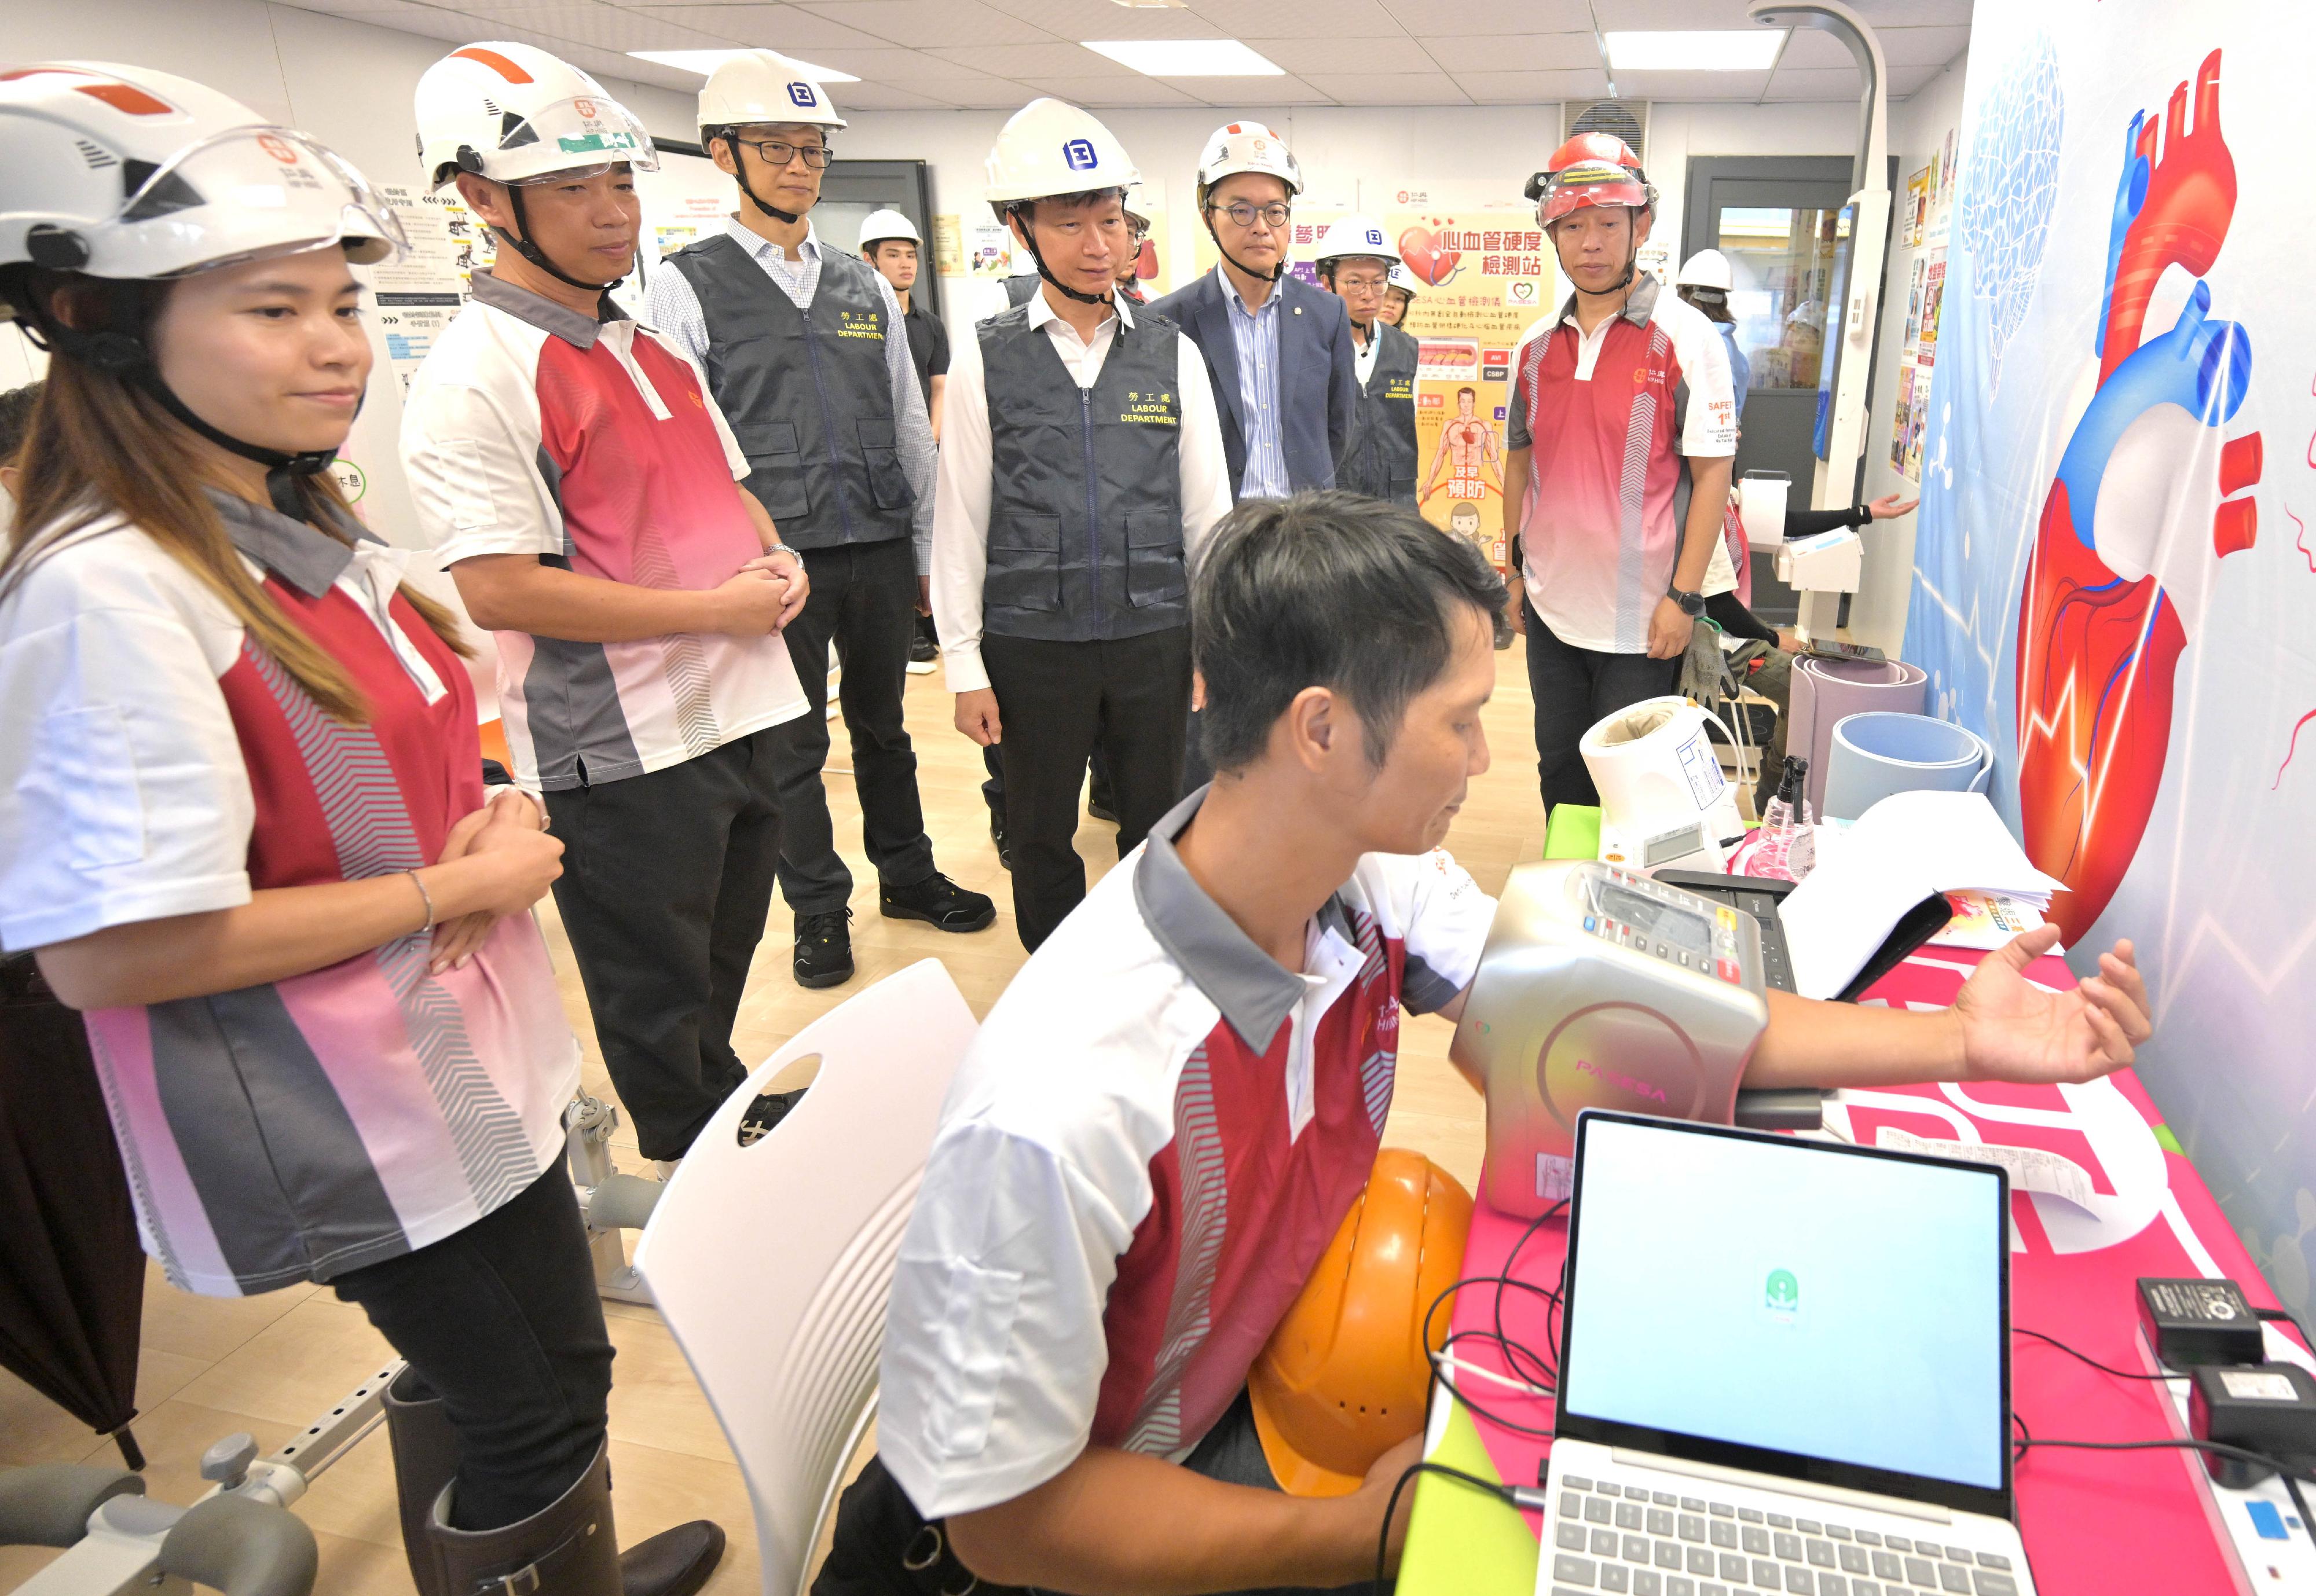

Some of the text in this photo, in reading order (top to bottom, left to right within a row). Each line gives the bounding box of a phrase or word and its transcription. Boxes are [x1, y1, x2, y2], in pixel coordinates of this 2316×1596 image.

[1442, 232, 1542, 251] 心血管硬度
[1482, 255, 1541, 276] 檢測站
[1435, 296, 1501, 307] 心血管檢測儀
[841, 311, 878, 322] 勞工處
[845, 322, 877, 331] LABOUR
[837, 329, 884, 341] DEPARTMEN
[1128, 391, 1170, 403] 勞工處
[1131, 405, 1167, 413] LABOUR
[1708, 401, 1734, 410] SAFET
[1120, 414, 1177, 424] DEPARTMENT
[1718, 412, 1731, 425] 1st
[1454, 466, 1479, 478] 及早
[1448, 479, 1486, 498] 預防
[1575, 1058, 1666, 1103] PASESA
